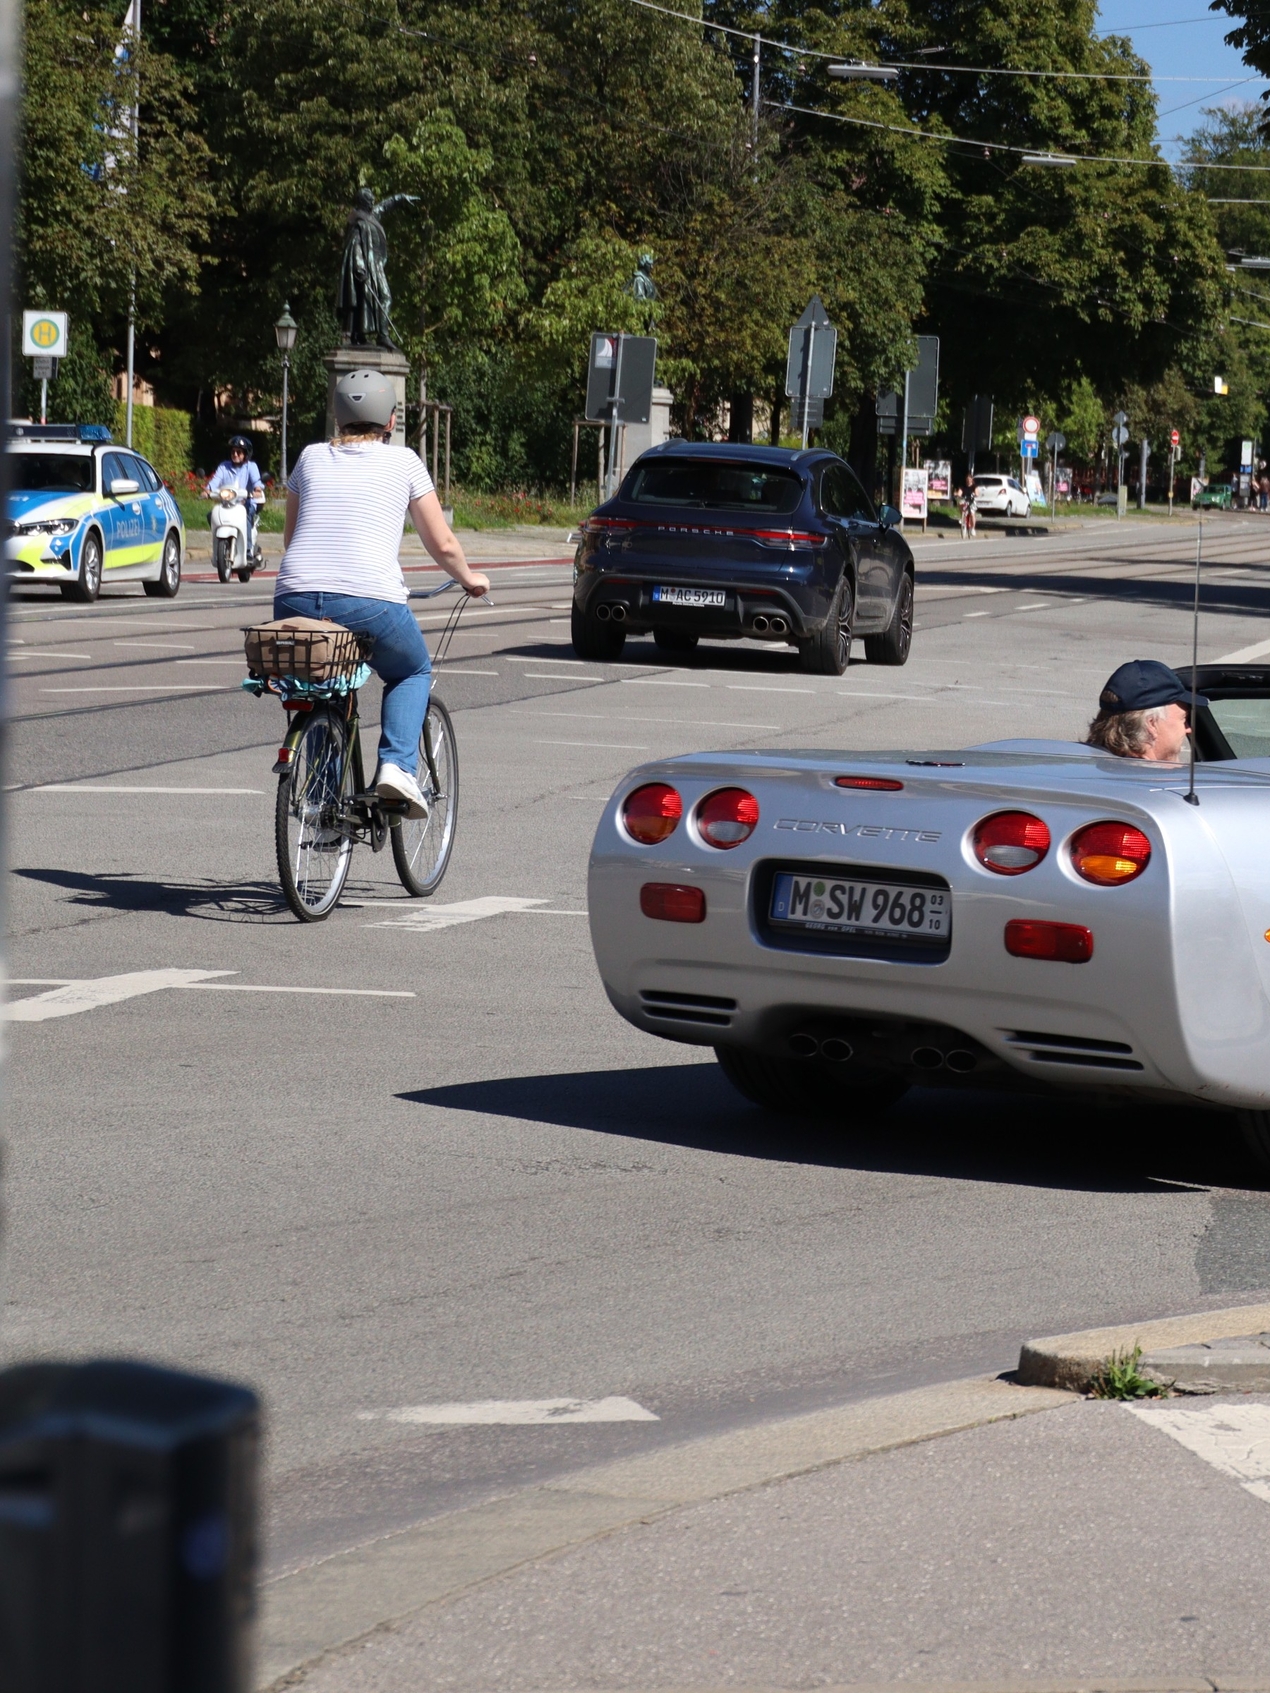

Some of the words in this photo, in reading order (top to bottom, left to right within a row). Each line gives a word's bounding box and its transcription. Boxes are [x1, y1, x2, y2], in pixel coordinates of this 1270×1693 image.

[116, 518, 140, 539] POLIZEI
[658, 526, 734, 536] PORSCHE
[660, 587, 669, 600] M
[676, 589, 692, 602] AC
[694, 590, 724, 604] 5910
[773, 818, 942, 843] CORVETTE
[778, 902, 785, 912] D
[790, 880, 812, 917] M
[826, 884, 867, 922] SW
[871, 889, 927, 929] 968
[930, 894, 944, 906] 03
[929, 918, 941, 930] 10
